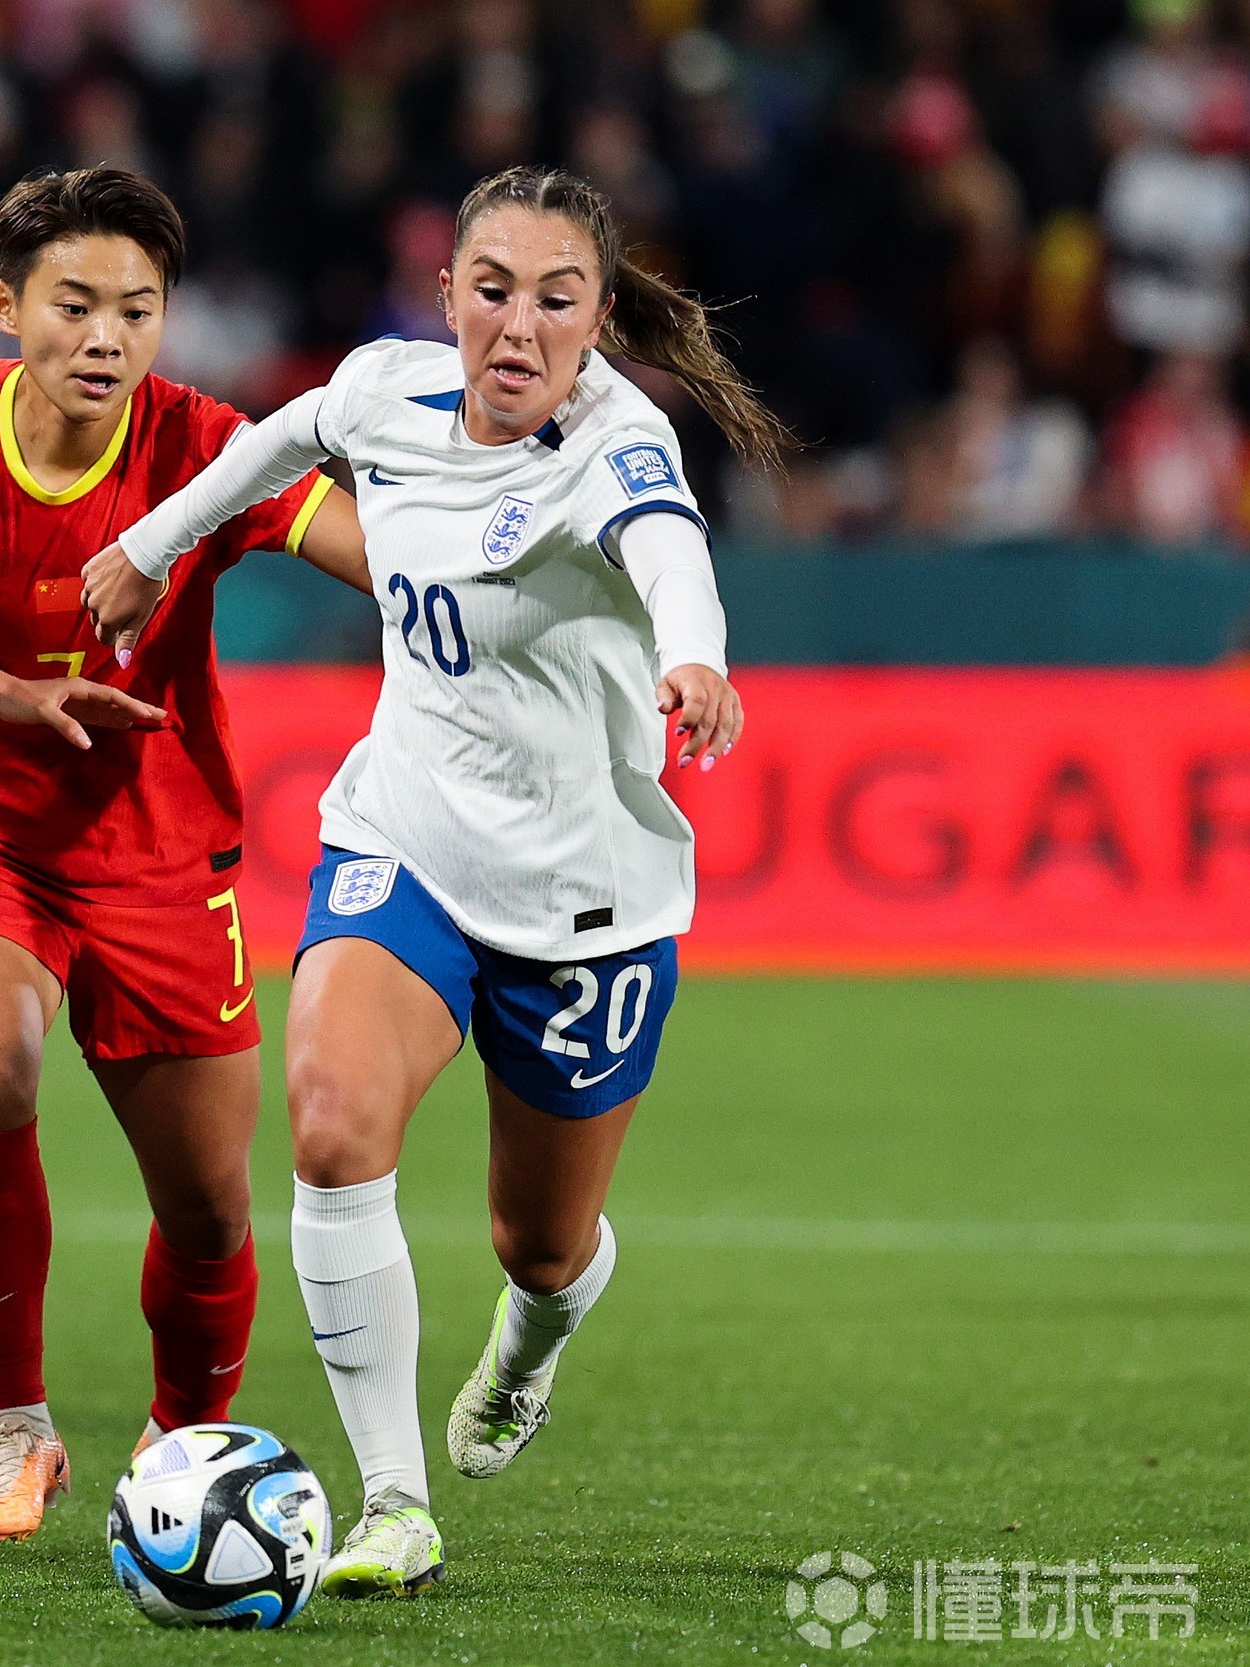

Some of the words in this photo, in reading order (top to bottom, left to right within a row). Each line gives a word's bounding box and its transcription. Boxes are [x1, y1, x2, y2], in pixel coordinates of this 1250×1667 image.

[388, 573, 470, 677] 20
[207, 887, 244, 987] 7
[540, 963, 654, 1060] 20
